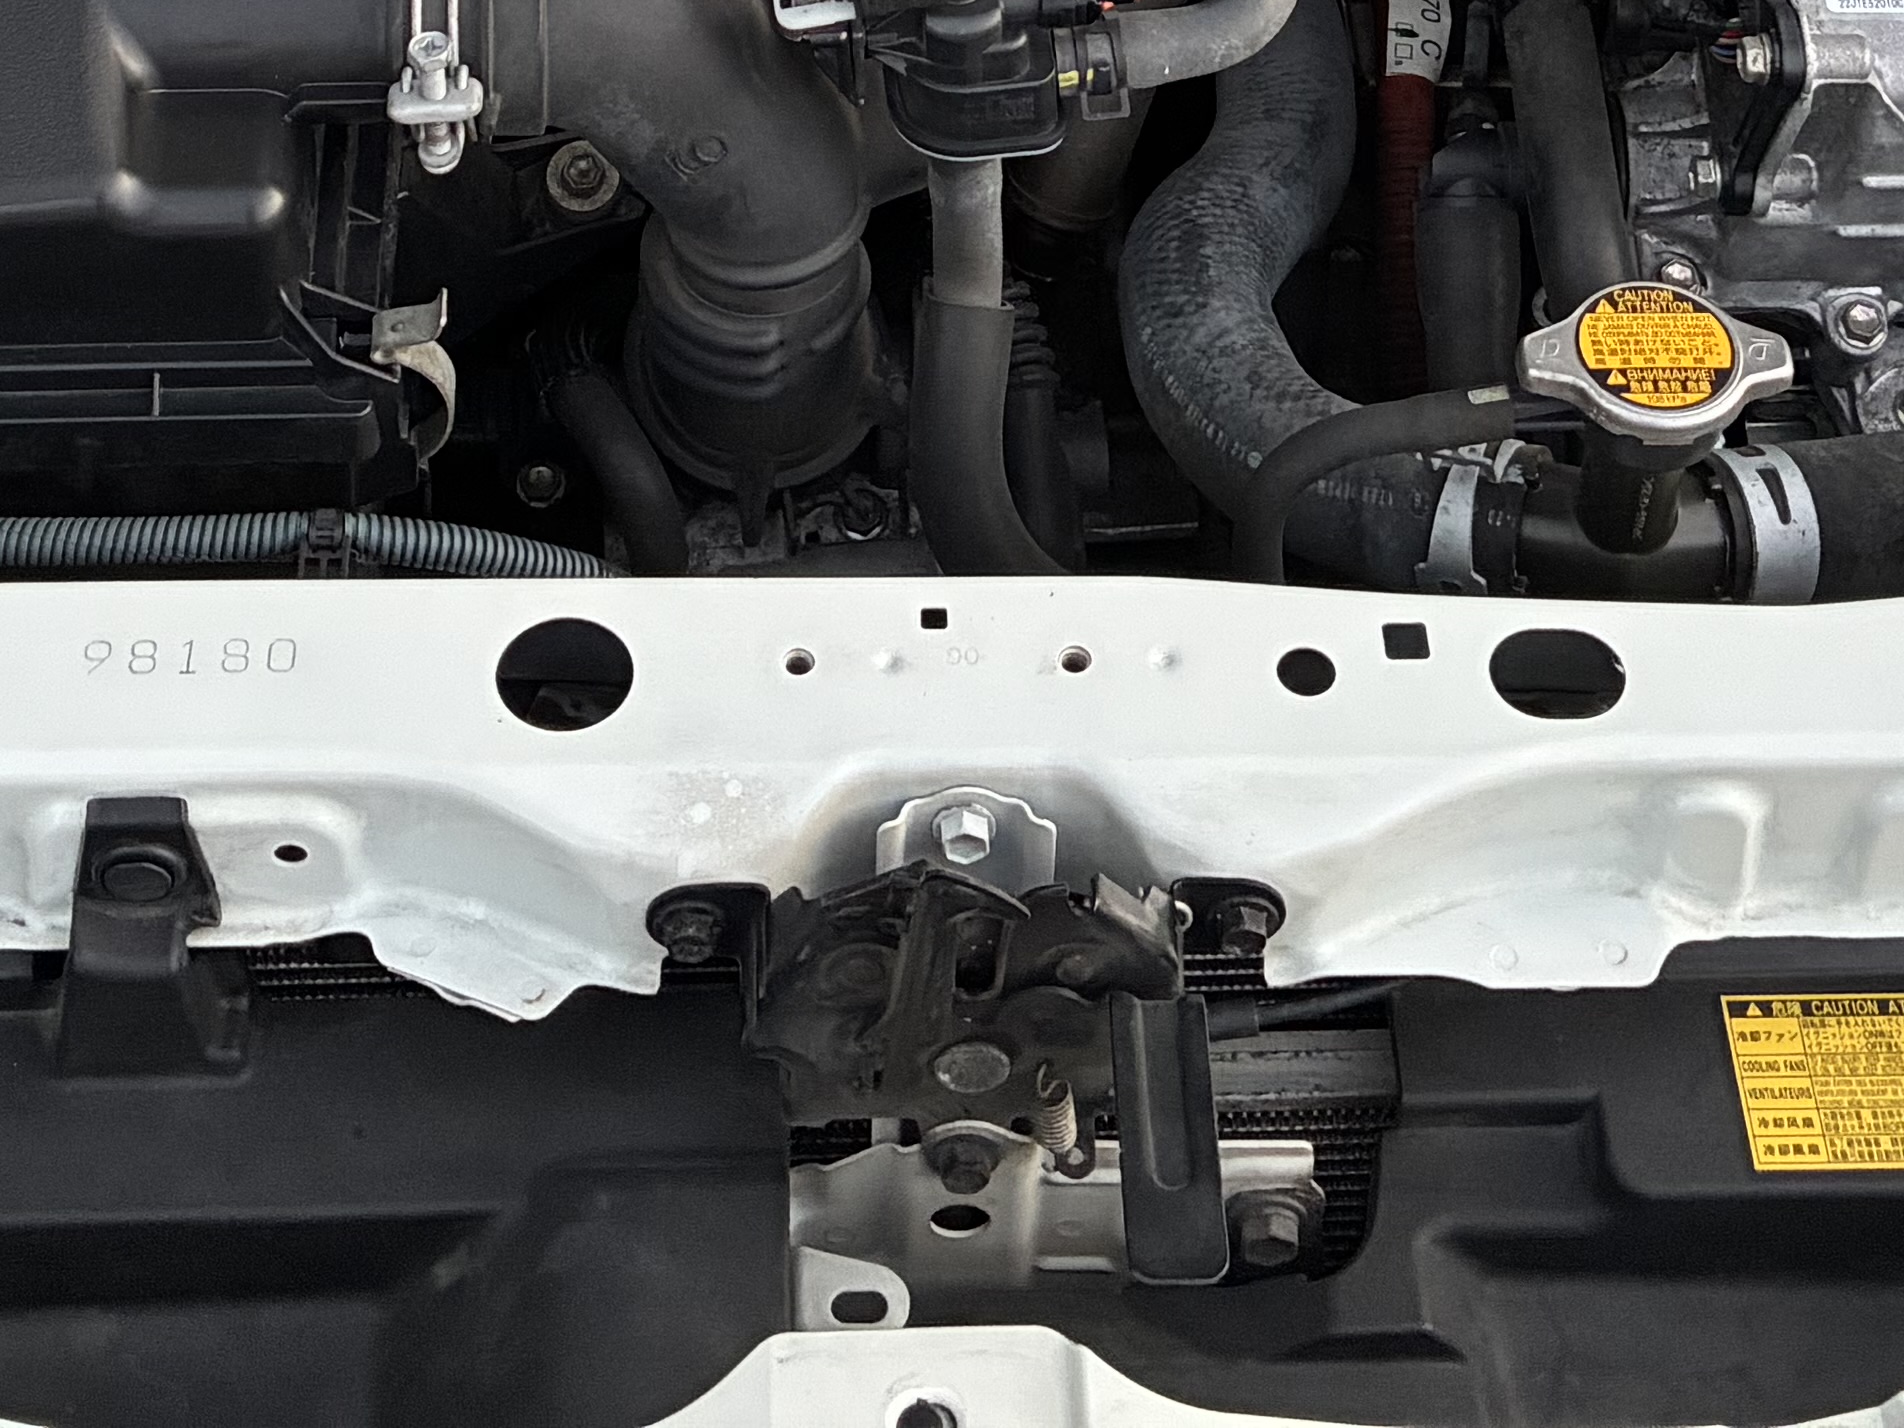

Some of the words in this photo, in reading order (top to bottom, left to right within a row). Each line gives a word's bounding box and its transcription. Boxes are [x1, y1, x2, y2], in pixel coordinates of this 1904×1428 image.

[1420, 39, 1443, 62] C
[1613, 289, 1674, 302] CAUTION
[1617, 301, 1694, 313] ATTENTION
[1627, 369, 1716, 381] ВНИМАНИЕ!
[84, 638, 297, 675] 98180
[1811, 1001, 1879, 1015] CAUTION
[1741, 1060, 1782, 1073] COOLING
[1784, 1059, 1808, 1072] FANS
[1747, 1087, 1813, 1100] VENTILATEURS
